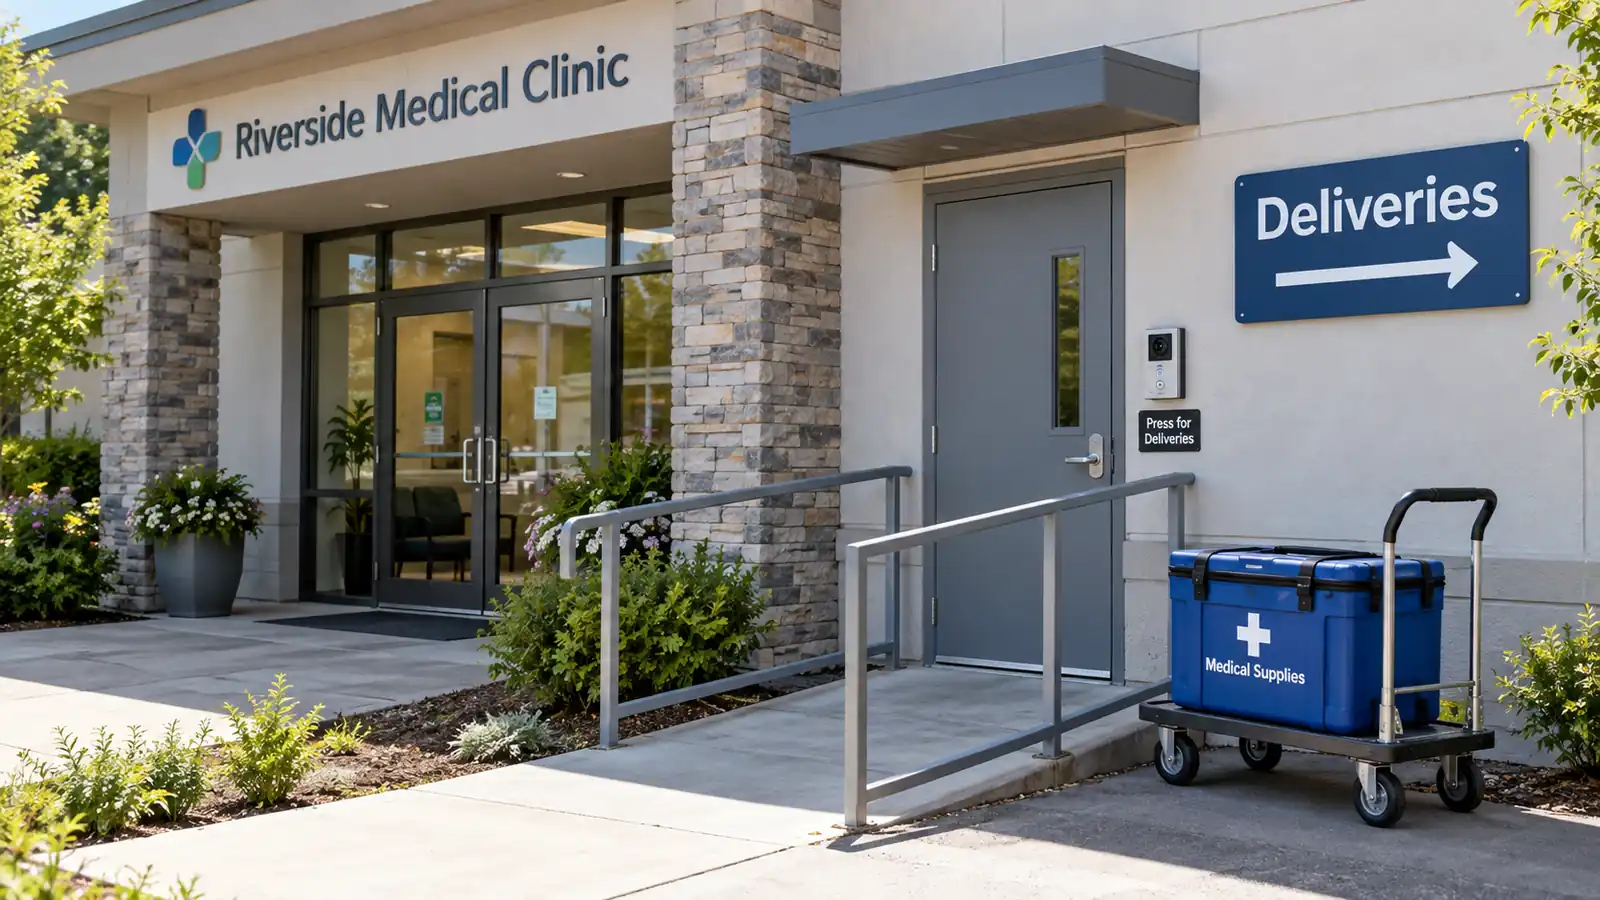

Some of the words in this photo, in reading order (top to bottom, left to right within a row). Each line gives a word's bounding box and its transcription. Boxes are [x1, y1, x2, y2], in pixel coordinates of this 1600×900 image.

[236, 101, 366, 159] Riverside
[376, 66, 509, 133] Medical
[523, 45, 629, 104] Clinic
[1257, 175, 1499, 241] Deliveries
[1146, 417, 1174, 429] Press
[1176, 416, 1192, 429] for
[1144, 432, 1195, 445] Deliveries
[1205, 656, 1251, 677] Medical
[1253, 663, 1306, 685] Supplies
